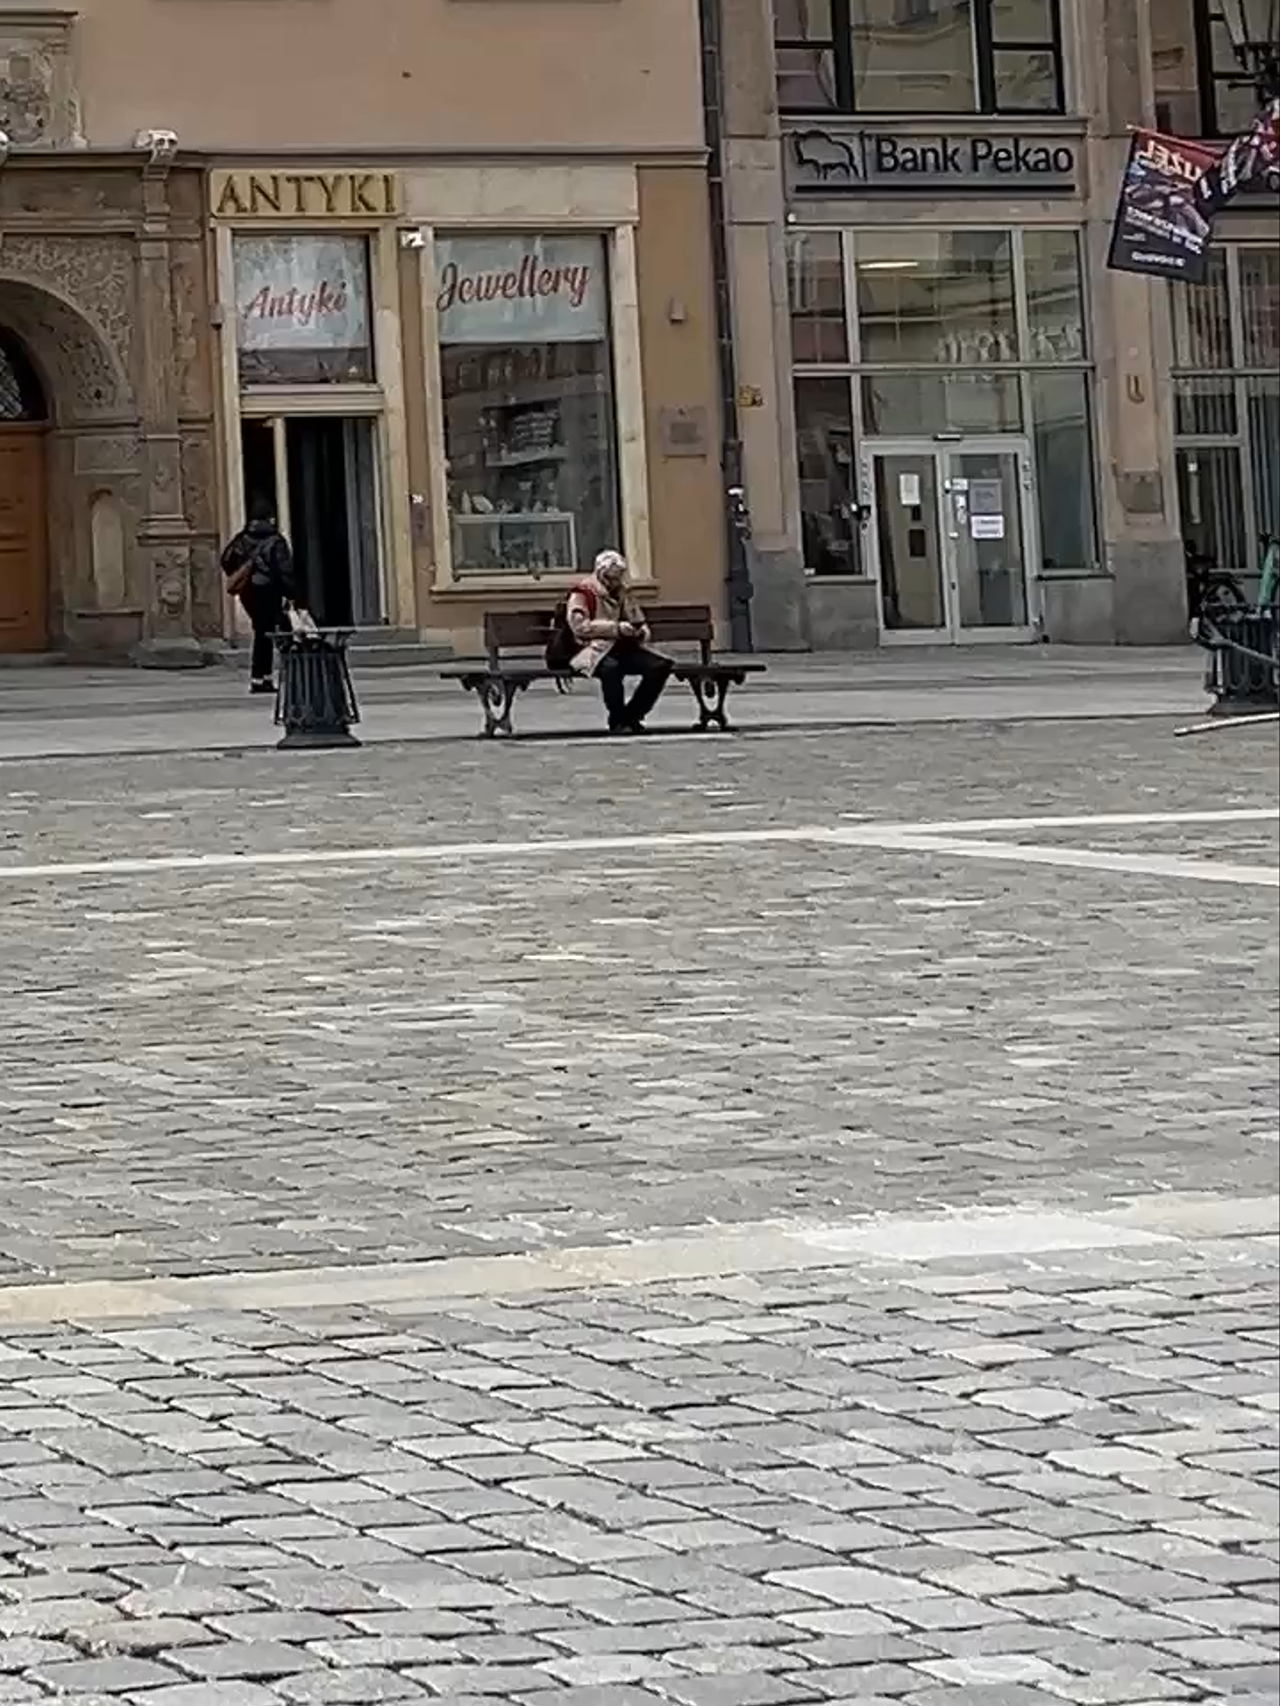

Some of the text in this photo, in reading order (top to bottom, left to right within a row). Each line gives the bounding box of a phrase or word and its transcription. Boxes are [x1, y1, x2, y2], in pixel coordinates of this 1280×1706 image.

[875, 136, 1074, 173] Bank Pekao
[216, 173, 397, 213] ANTYKI
[243, 280, 348, 326] Antyki
[436, 254, 590, 313] Jewellery
